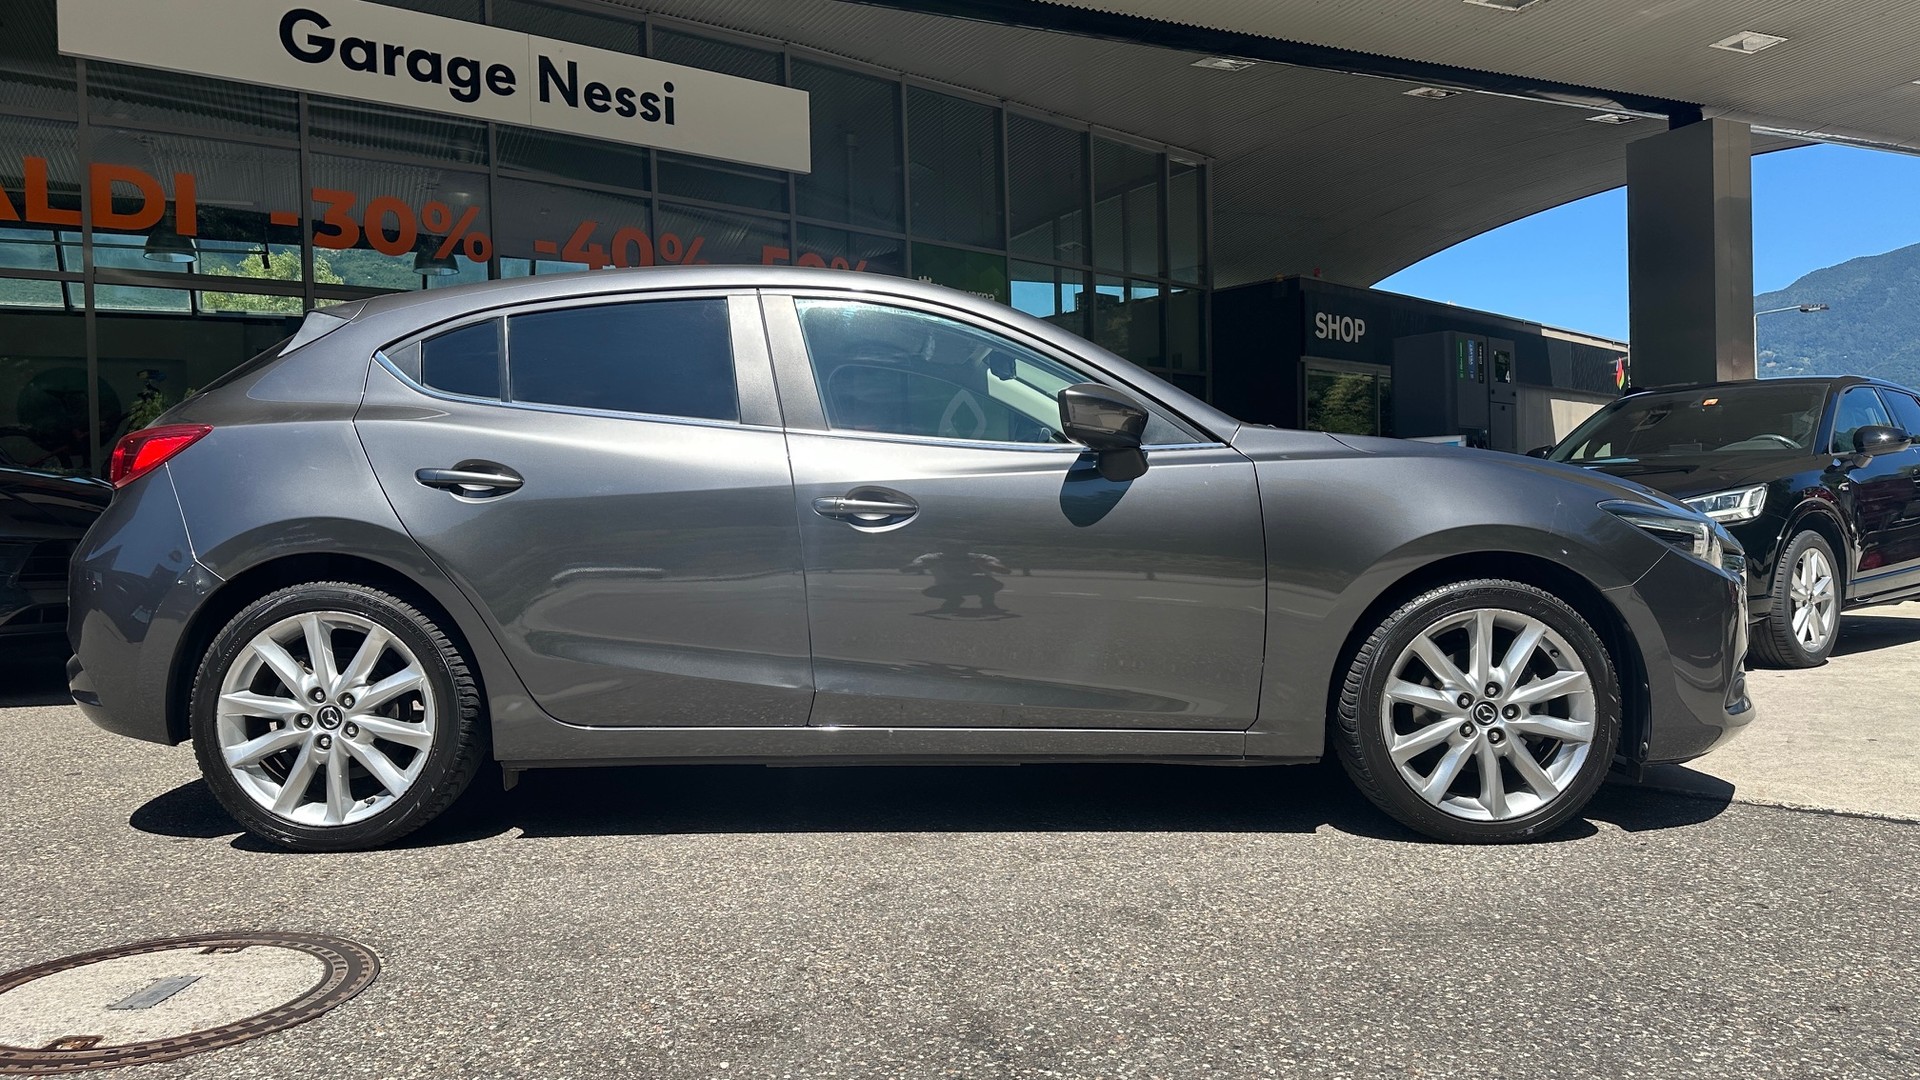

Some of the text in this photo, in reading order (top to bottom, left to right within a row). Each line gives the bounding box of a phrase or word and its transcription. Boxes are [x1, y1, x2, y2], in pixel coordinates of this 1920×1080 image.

[278, 8, 676, 126] Garage Nessi
[269, 187, 493, 263] -30%
[534, 221, 710, 269] -40%
[1314, 311, 1366, 344] SHOP
[1504, 370, 1512, 384] 4
